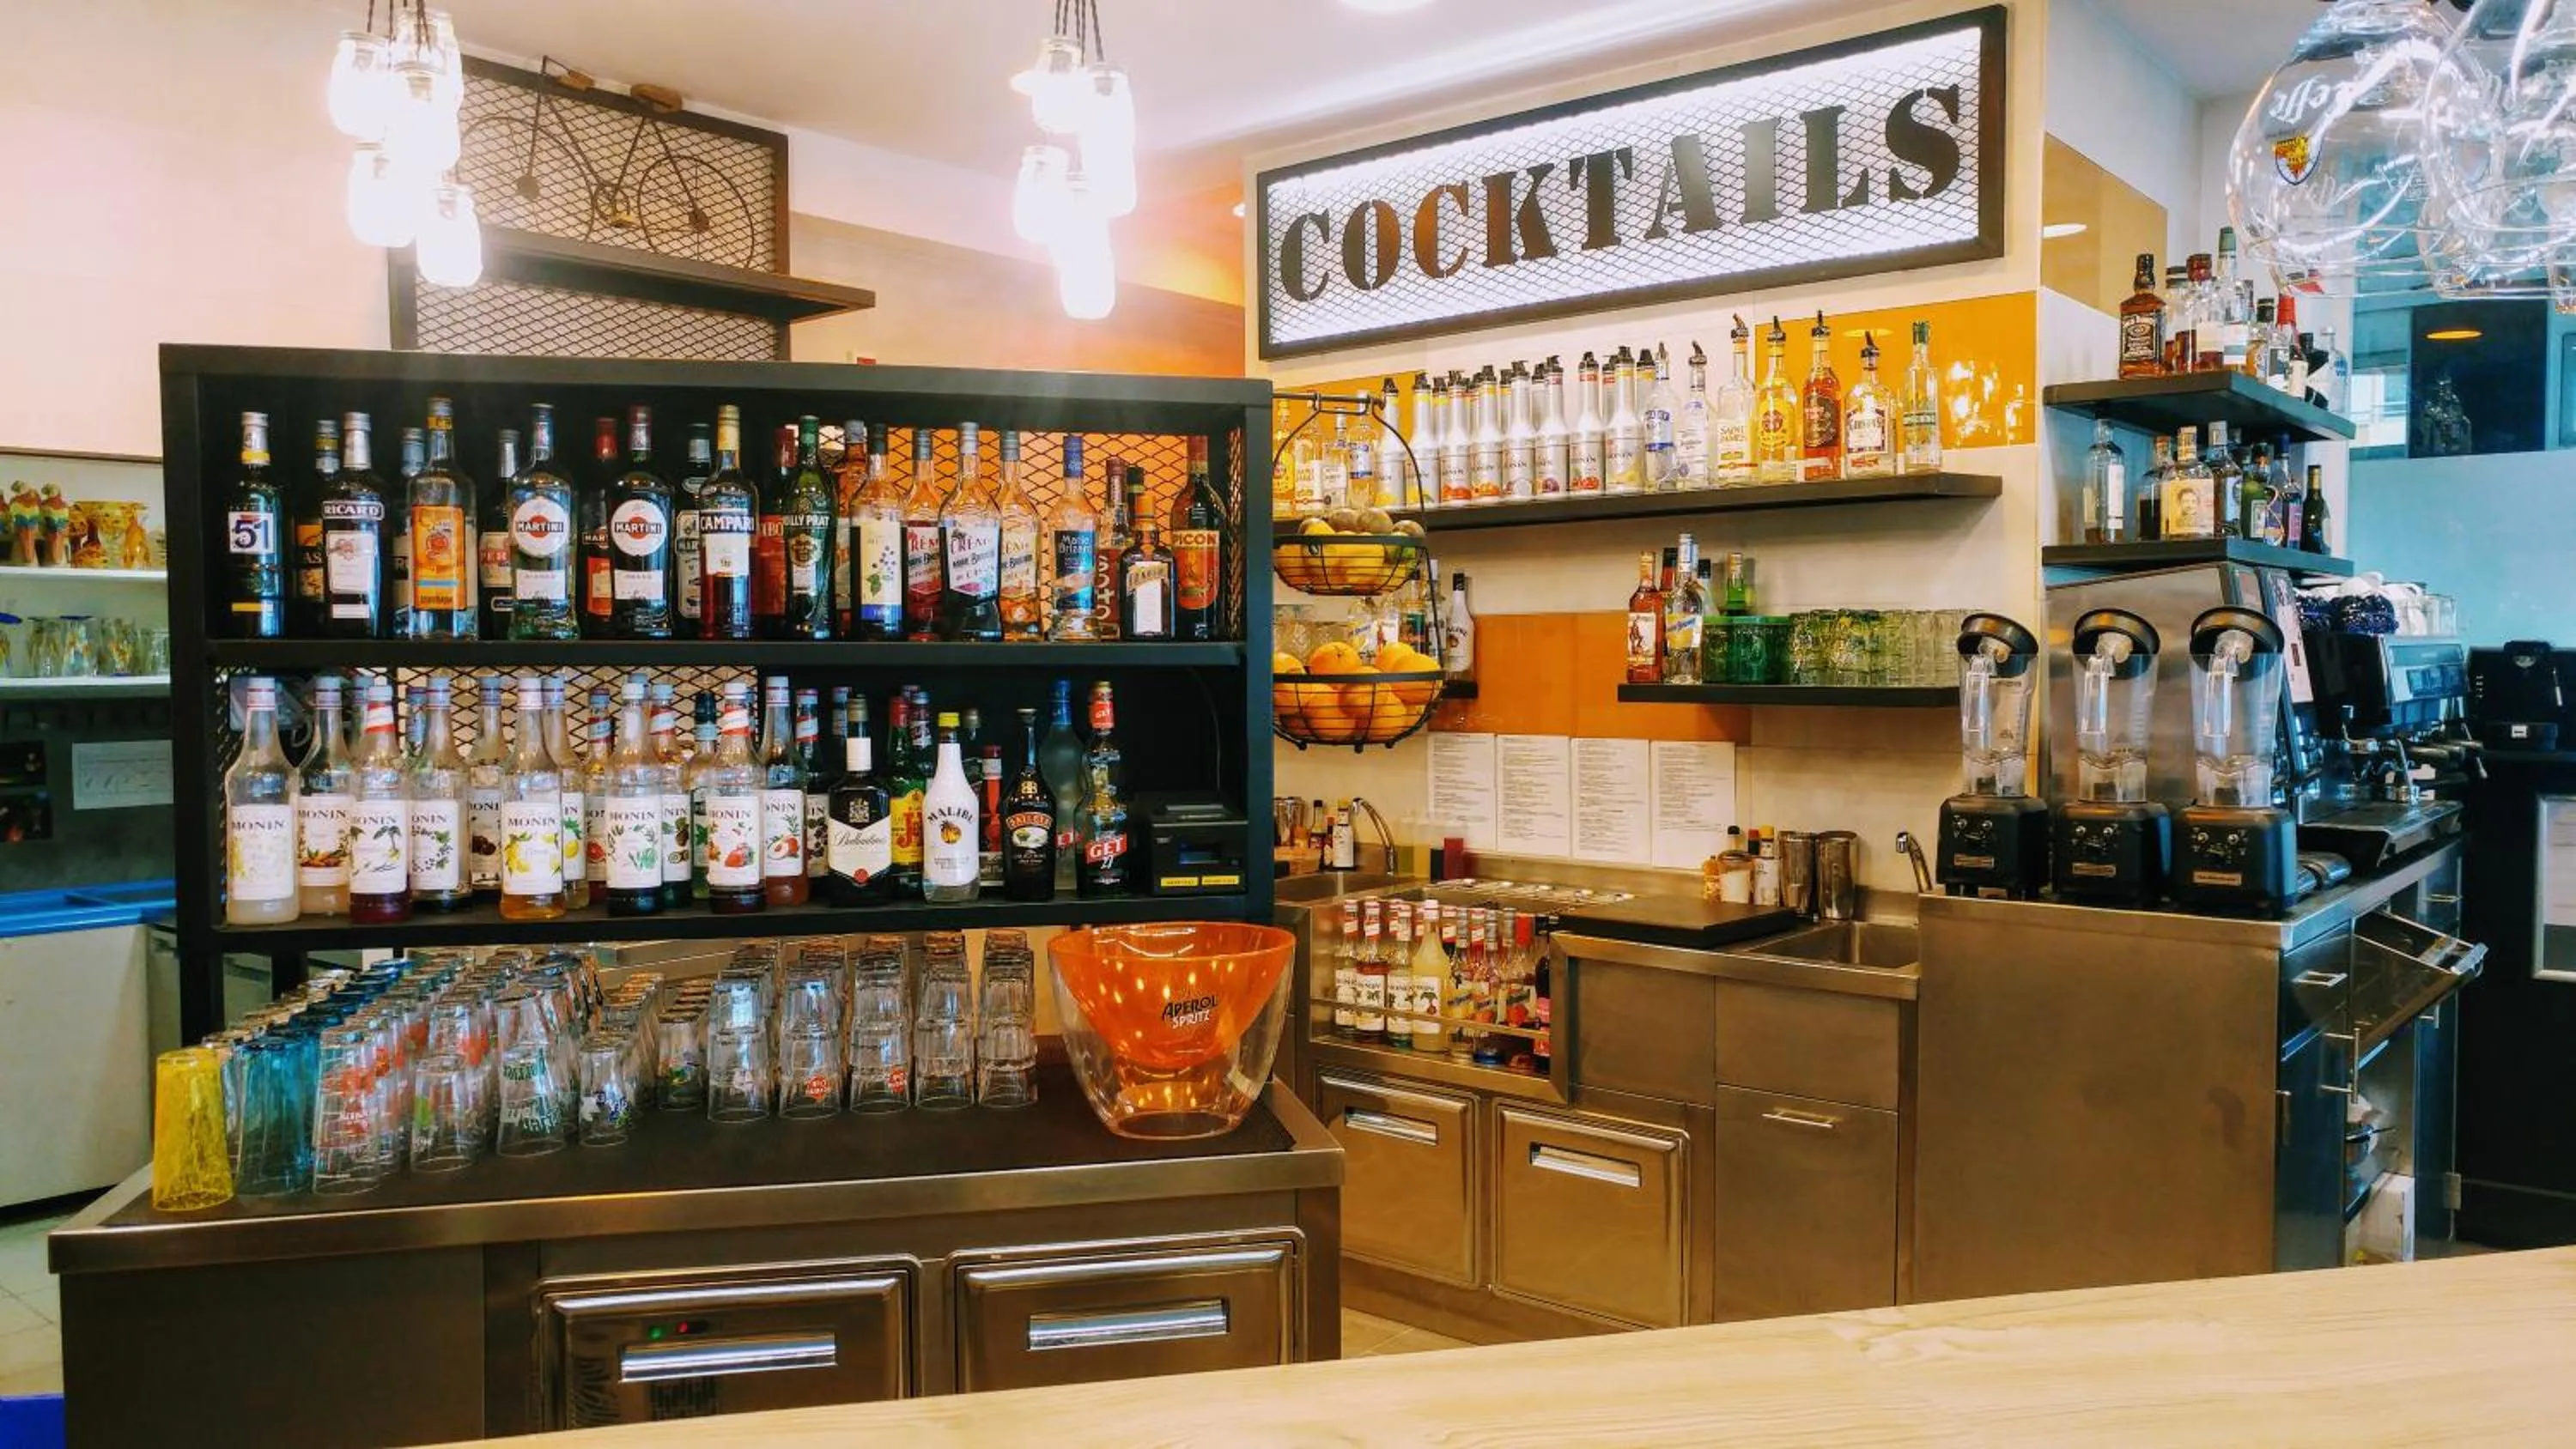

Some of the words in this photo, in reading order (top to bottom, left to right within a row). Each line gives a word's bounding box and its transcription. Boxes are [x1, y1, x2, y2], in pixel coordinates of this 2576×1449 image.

[1279, 83, 1962, 302] COCKTAILS
[324, 505, 380, 516] RICARD
[516, 521, 564, 532] MARTINI
[615, 521, 661, 534] MARTINI
[700, 515, 755, 530] CAMPARI
[234, 519, 269, 549] 51
[1173, 533, 1217, 544] PICON
[470, 802, 500, 811] ONI
[765, 803, 797, 812] ONIN
[411, 815, 447, 824] ONIN
[609, 810, 655, 820] MONIN
[232, 819, 284, 831] MONIN
[508, 817, 556, 827] MONIN
[1090, 837, 1124, 858] GET
[1161, 995, 1219, 1020] APEROL
[1172, 1009, 1211, 1029] SPRITZ
